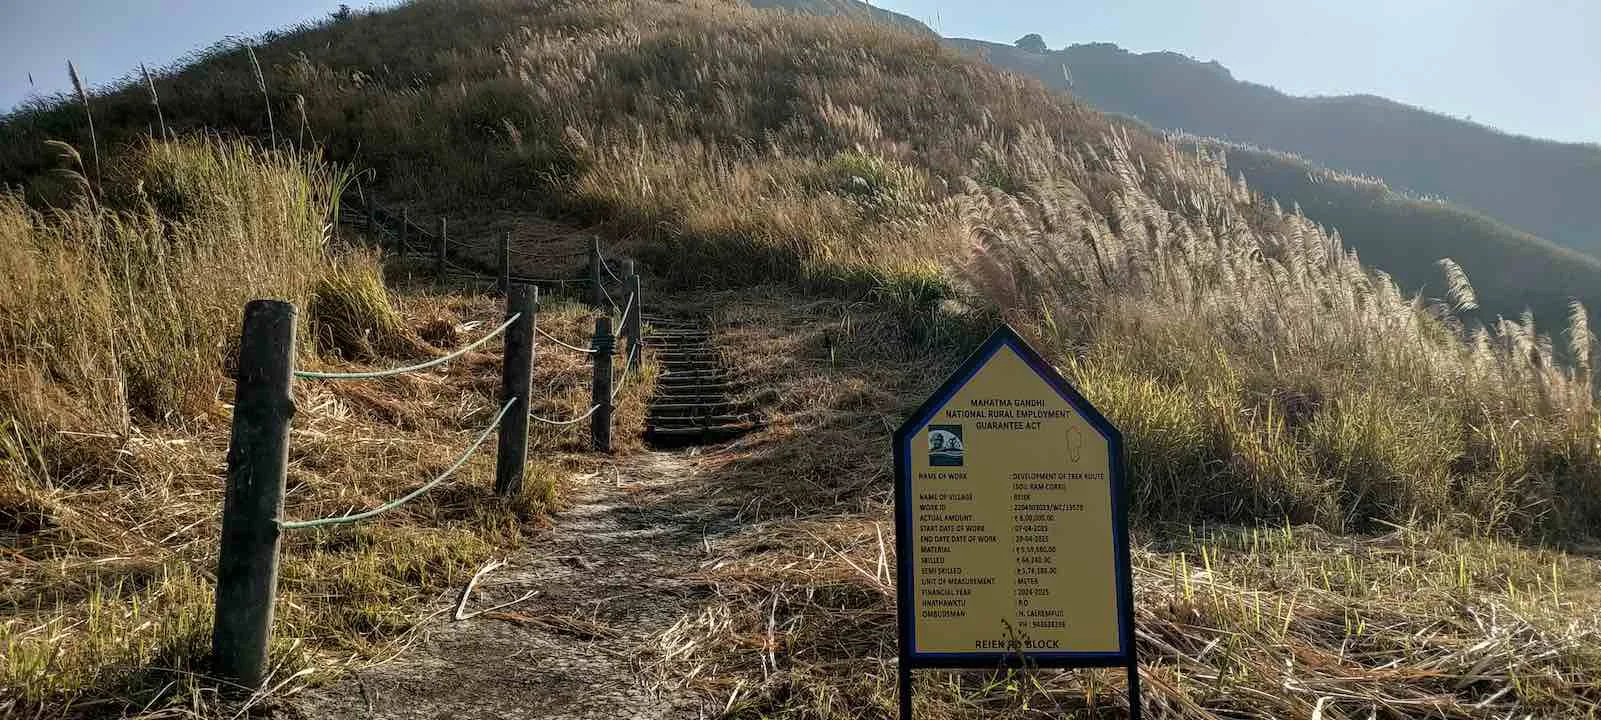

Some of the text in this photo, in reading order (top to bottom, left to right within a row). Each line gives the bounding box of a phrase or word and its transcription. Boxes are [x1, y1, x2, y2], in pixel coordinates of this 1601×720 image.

[970, 399, 1045, 407] MAHATMA GANDHI
[945, 410, 1072, 418] NATIONAL RURAL EMPLOYMENT
[976, 421, 1041, 430] GUARANTEE ACT
[918, 472, 968, 480] NAME OF WORK
[1012, 472, 1057, 480] DEVELOPMENT
[1058, 472, 1067, 480] OF
[1084, 472, 1104, 480] ROUTE
[919, 493, 973, 501] NAME OF VILLAGE
[919, 503, 946, 511] WORK ID
[919, 514, 973, 522] ACTUAL AMOUNT
[920, 535, 997, 543] END DATE DATE OF WORK
[921, 567, 962, 575] SEMI SKILLED
[1017, 577, 1039, 585] METER
[921, 588, 972, 596] FINANCIAL YEAR
[921, 610, 966, 618] OMBUDSMAN
[975, 639, 1005, 648] REIEK
[1025, 639, 1060, 648] BLOCK
